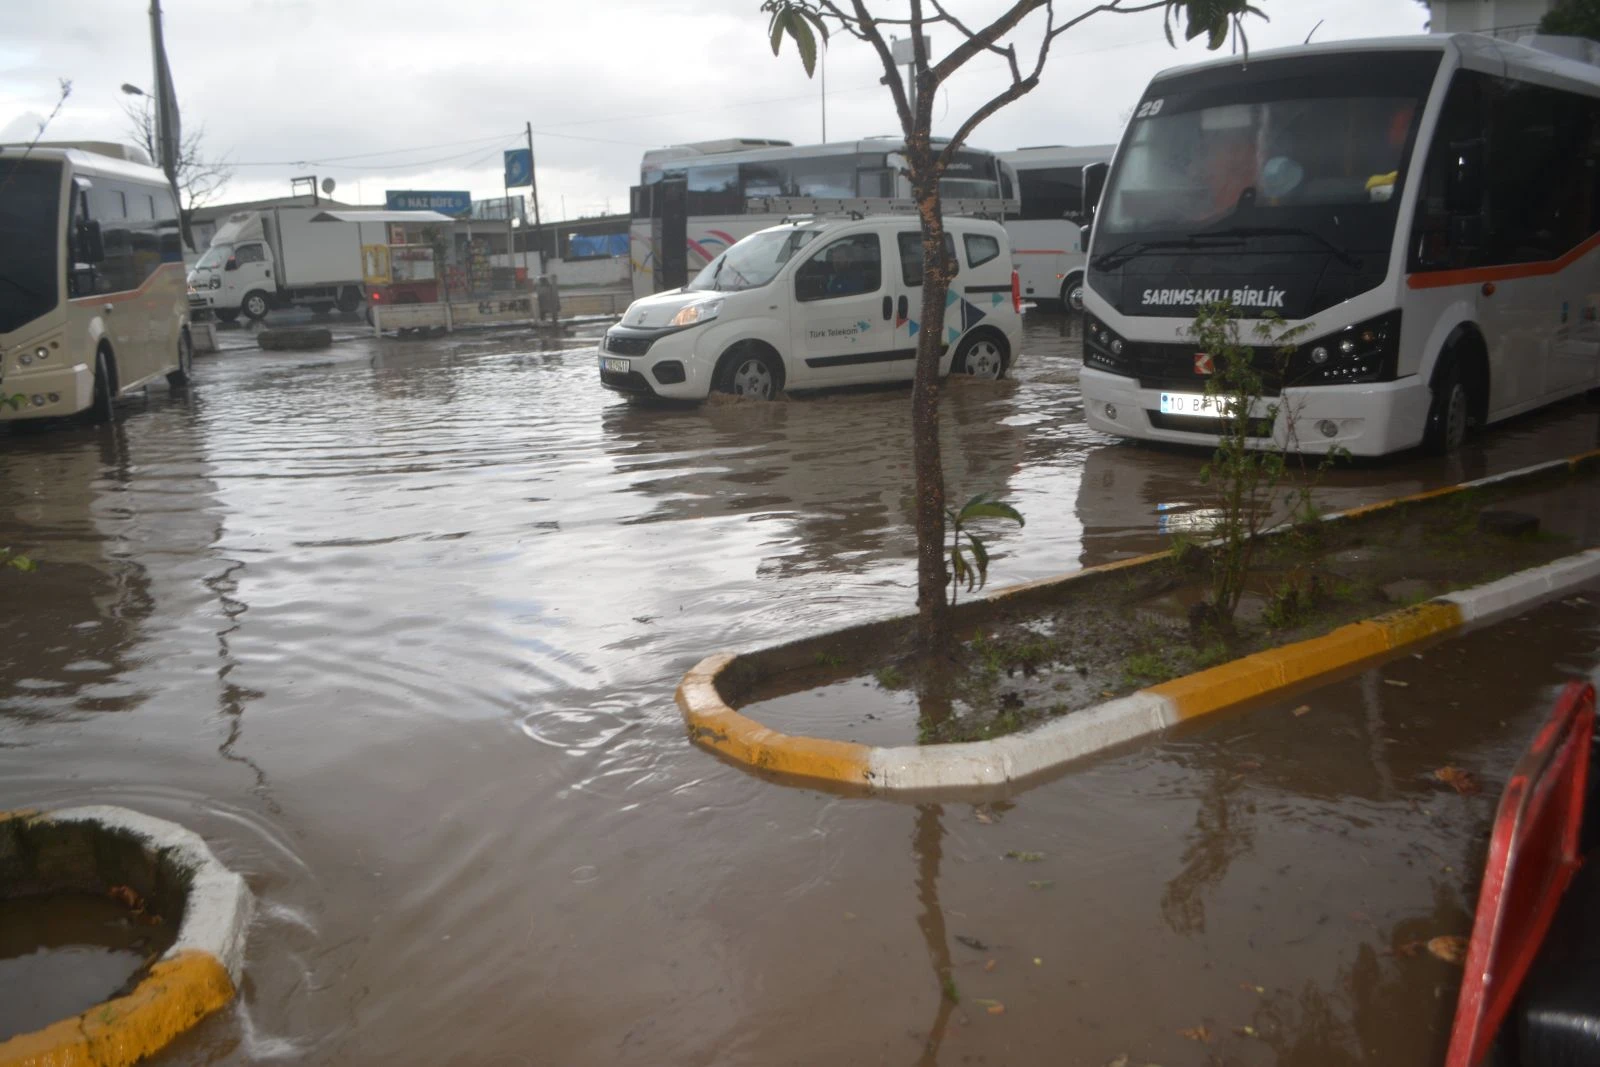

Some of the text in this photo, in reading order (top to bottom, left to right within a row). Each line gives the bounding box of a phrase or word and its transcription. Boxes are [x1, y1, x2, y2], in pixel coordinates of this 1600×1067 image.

[1136, 98, 1165, 118] 29
[1231, 285, 1286, 307] BİRLİK
[809, 328, 858, 338] Türk Telekom
[1170, 397, 1184, 411] 10
